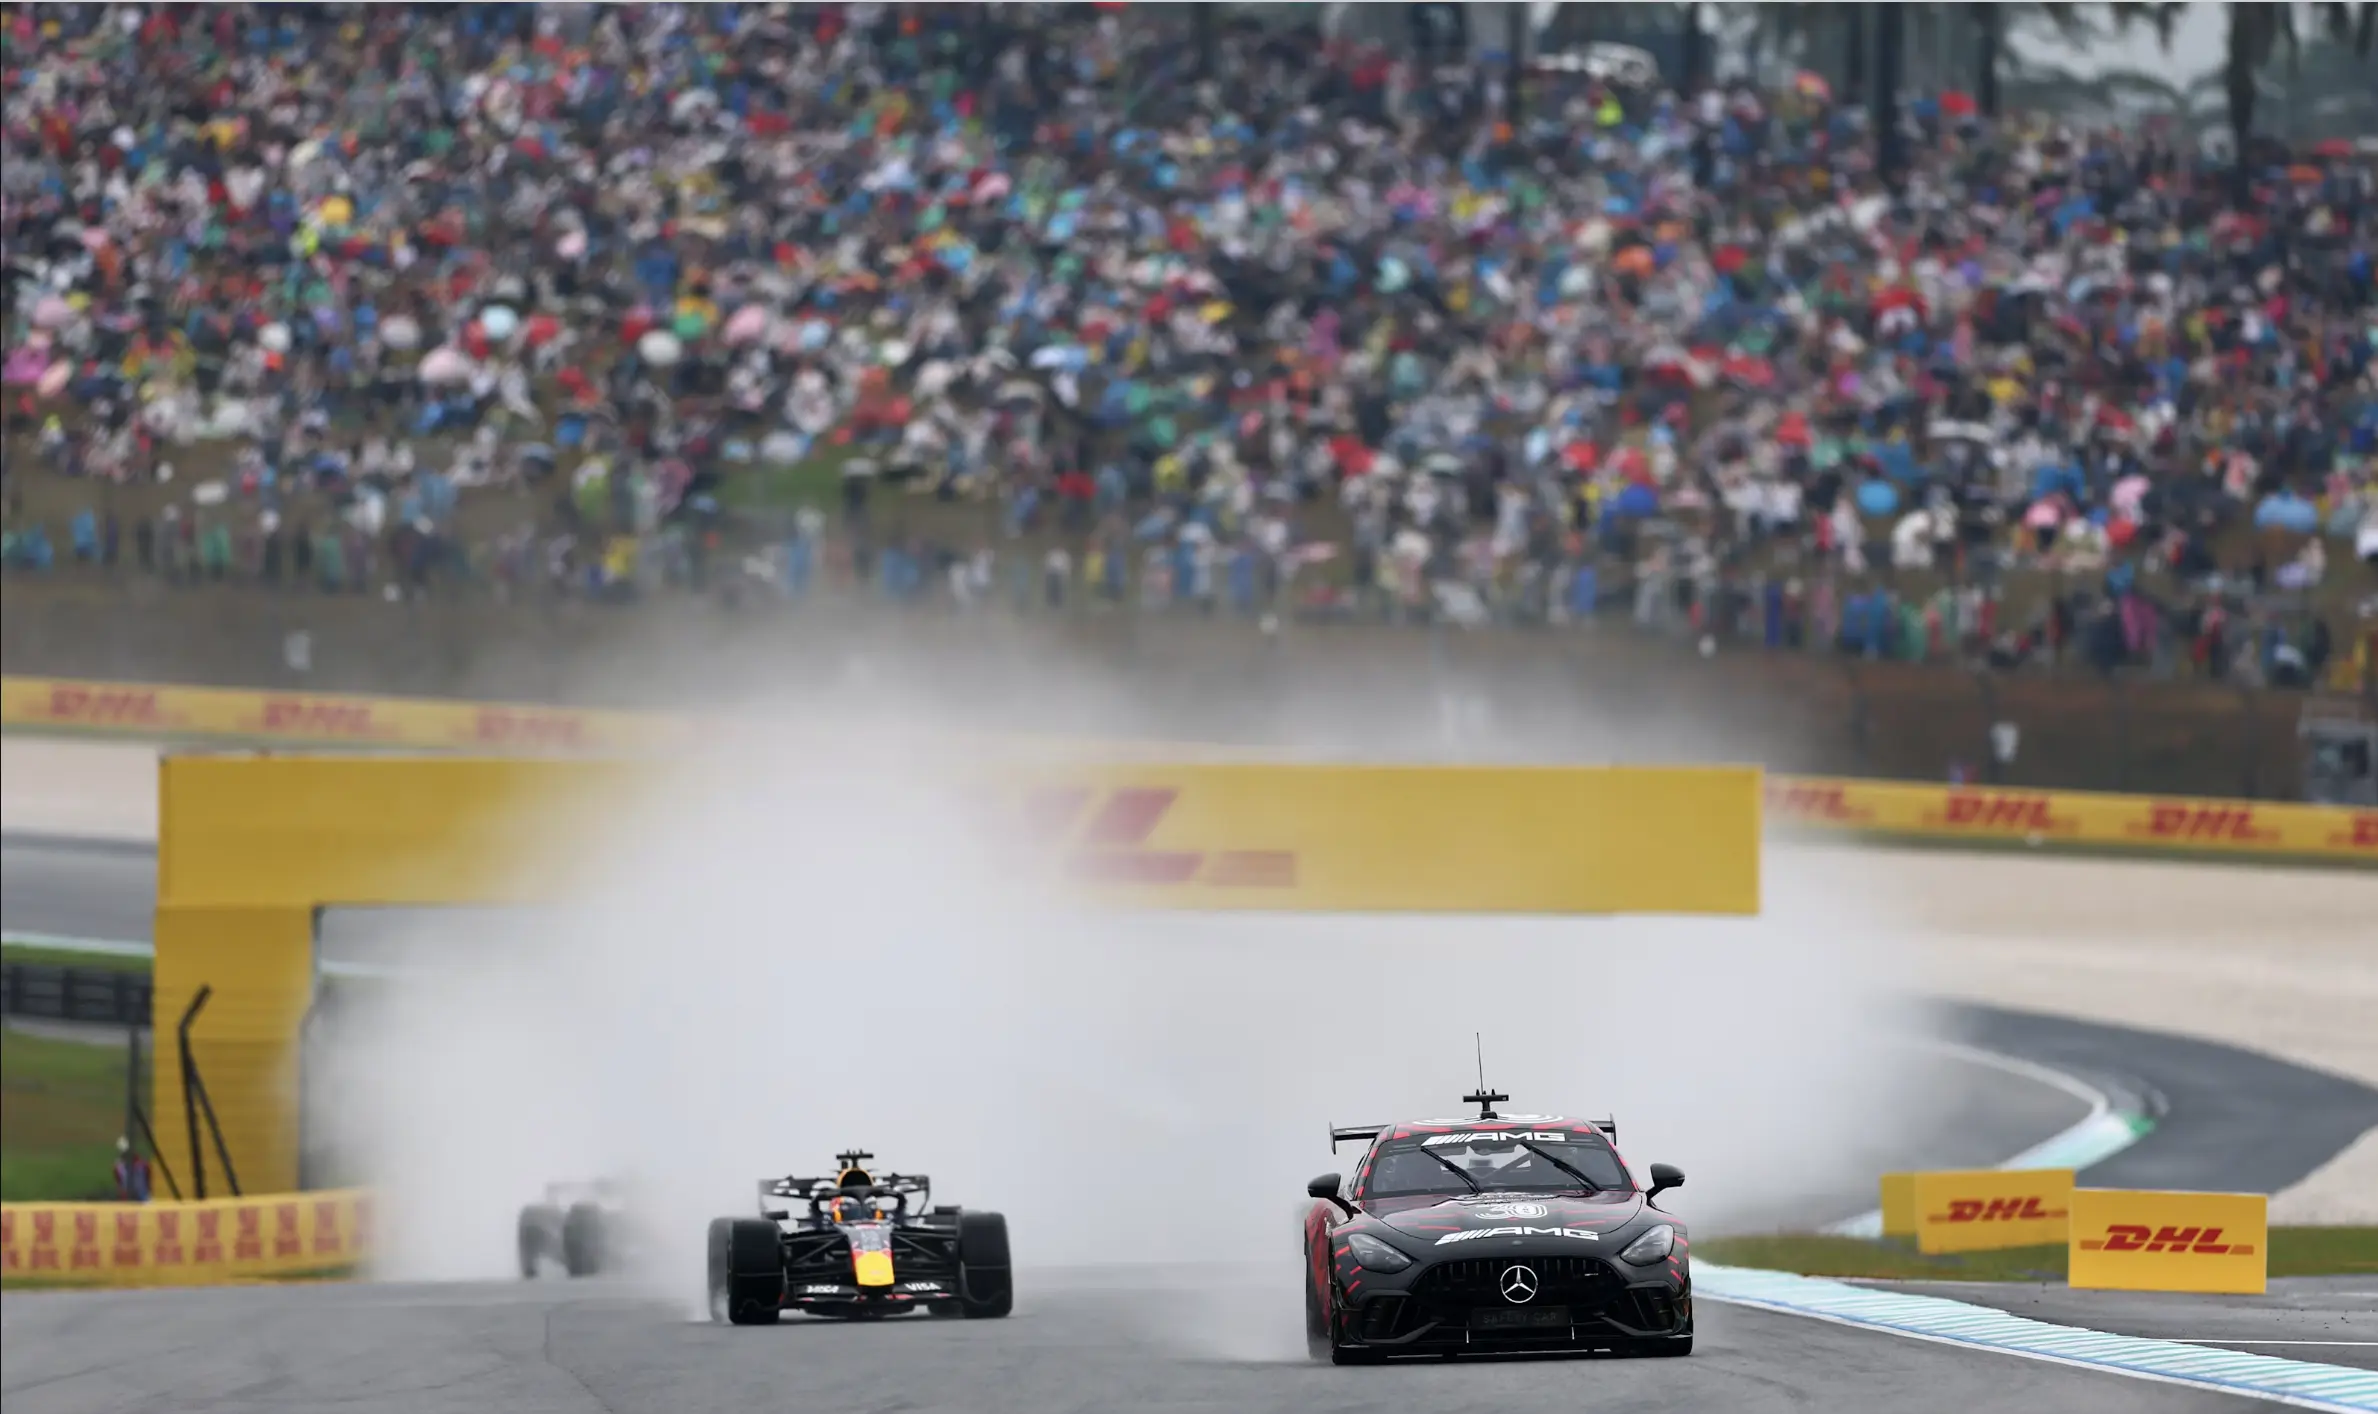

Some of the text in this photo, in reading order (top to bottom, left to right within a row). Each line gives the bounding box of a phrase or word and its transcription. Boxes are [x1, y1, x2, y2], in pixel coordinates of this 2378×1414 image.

[1946, 794, 2054, 828] DHL
[2150, 805, 2257, 840] DHL
[1465, 1132, 1566, 1142] AMG
[1948, 1197, 2048, 1222] DHL
[1484, 1226, 1599, 1241] AMG
[2103, 1225, 2232, 1254] DHL
[905, 1282, 942, 1292] VISA
